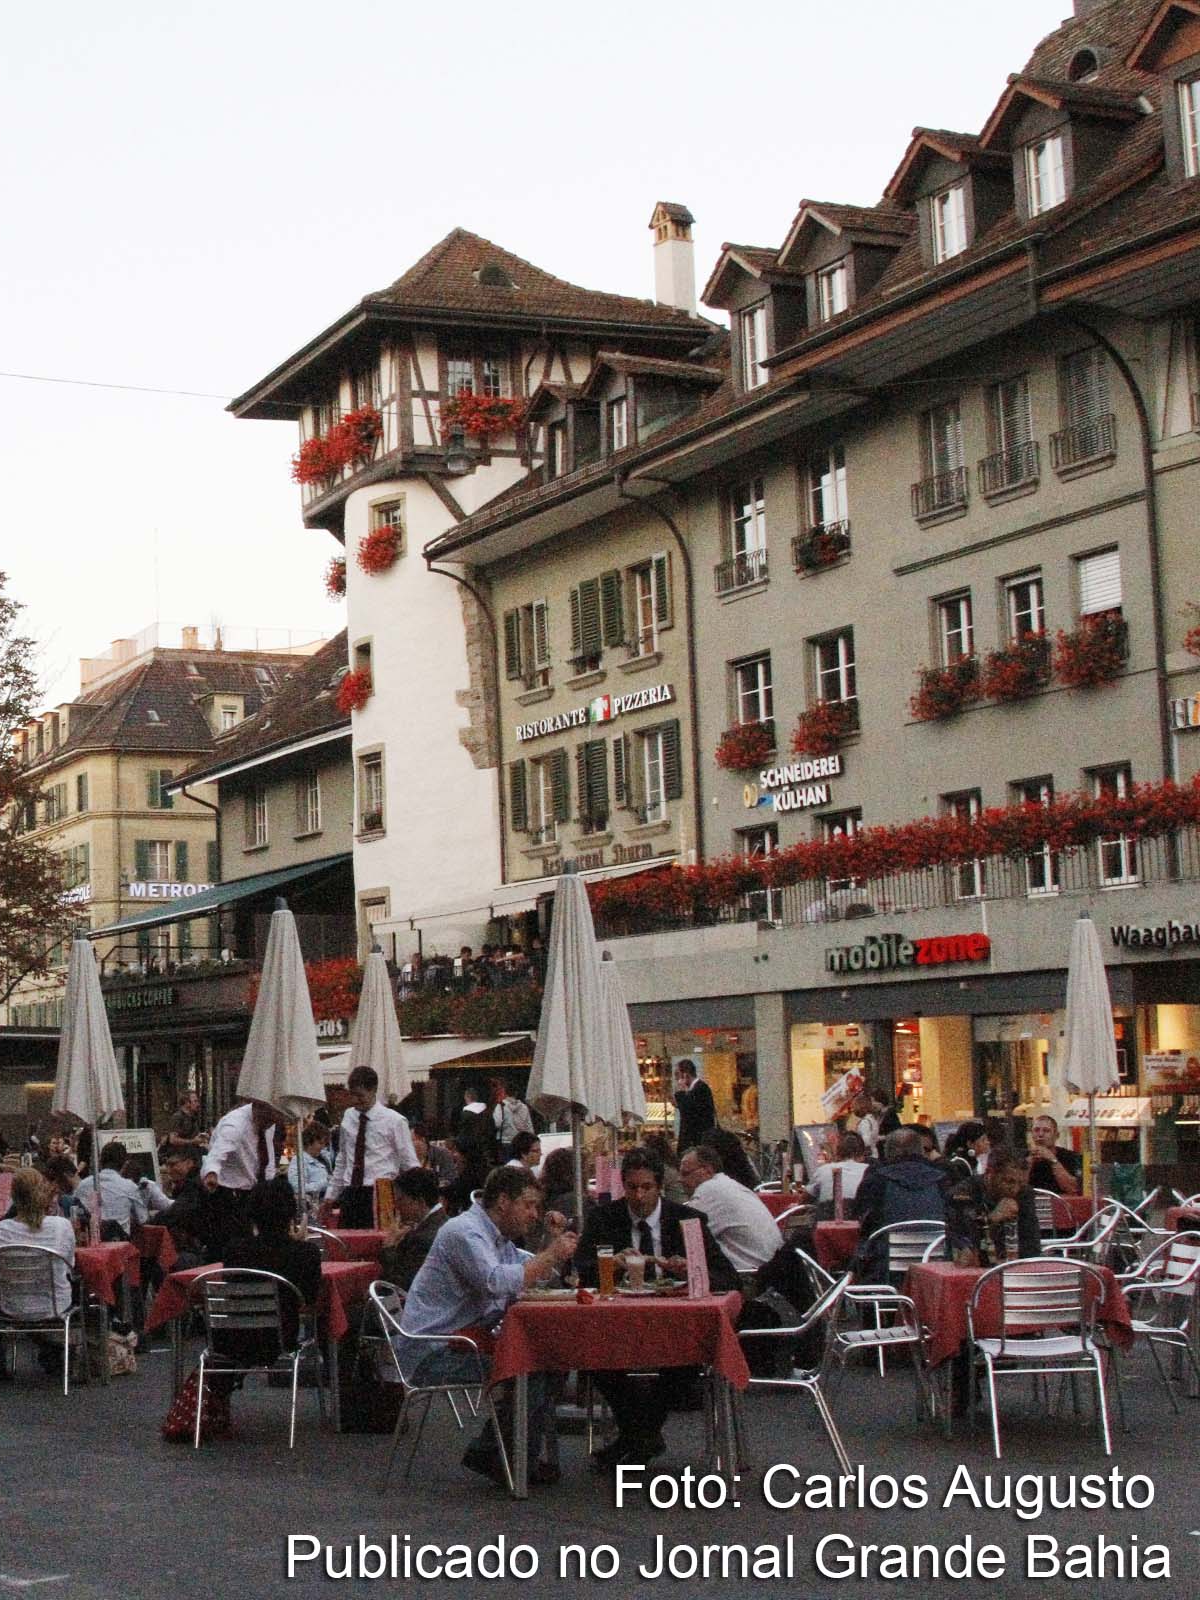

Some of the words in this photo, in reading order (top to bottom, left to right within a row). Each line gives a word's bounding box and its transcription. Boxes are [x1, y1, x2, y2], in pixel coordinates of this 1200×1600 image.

[515, 706, 587, 741] RISTORANTE
[613, 684, 672, 715] PIZZERIA
[760, 755, 841, 789] SCHNEIDEREI
[772, 784, 827, 812] KÜLHAN
[129, 883, 215, 898] METROP
[825, 932, 992, 973] mobilezone
